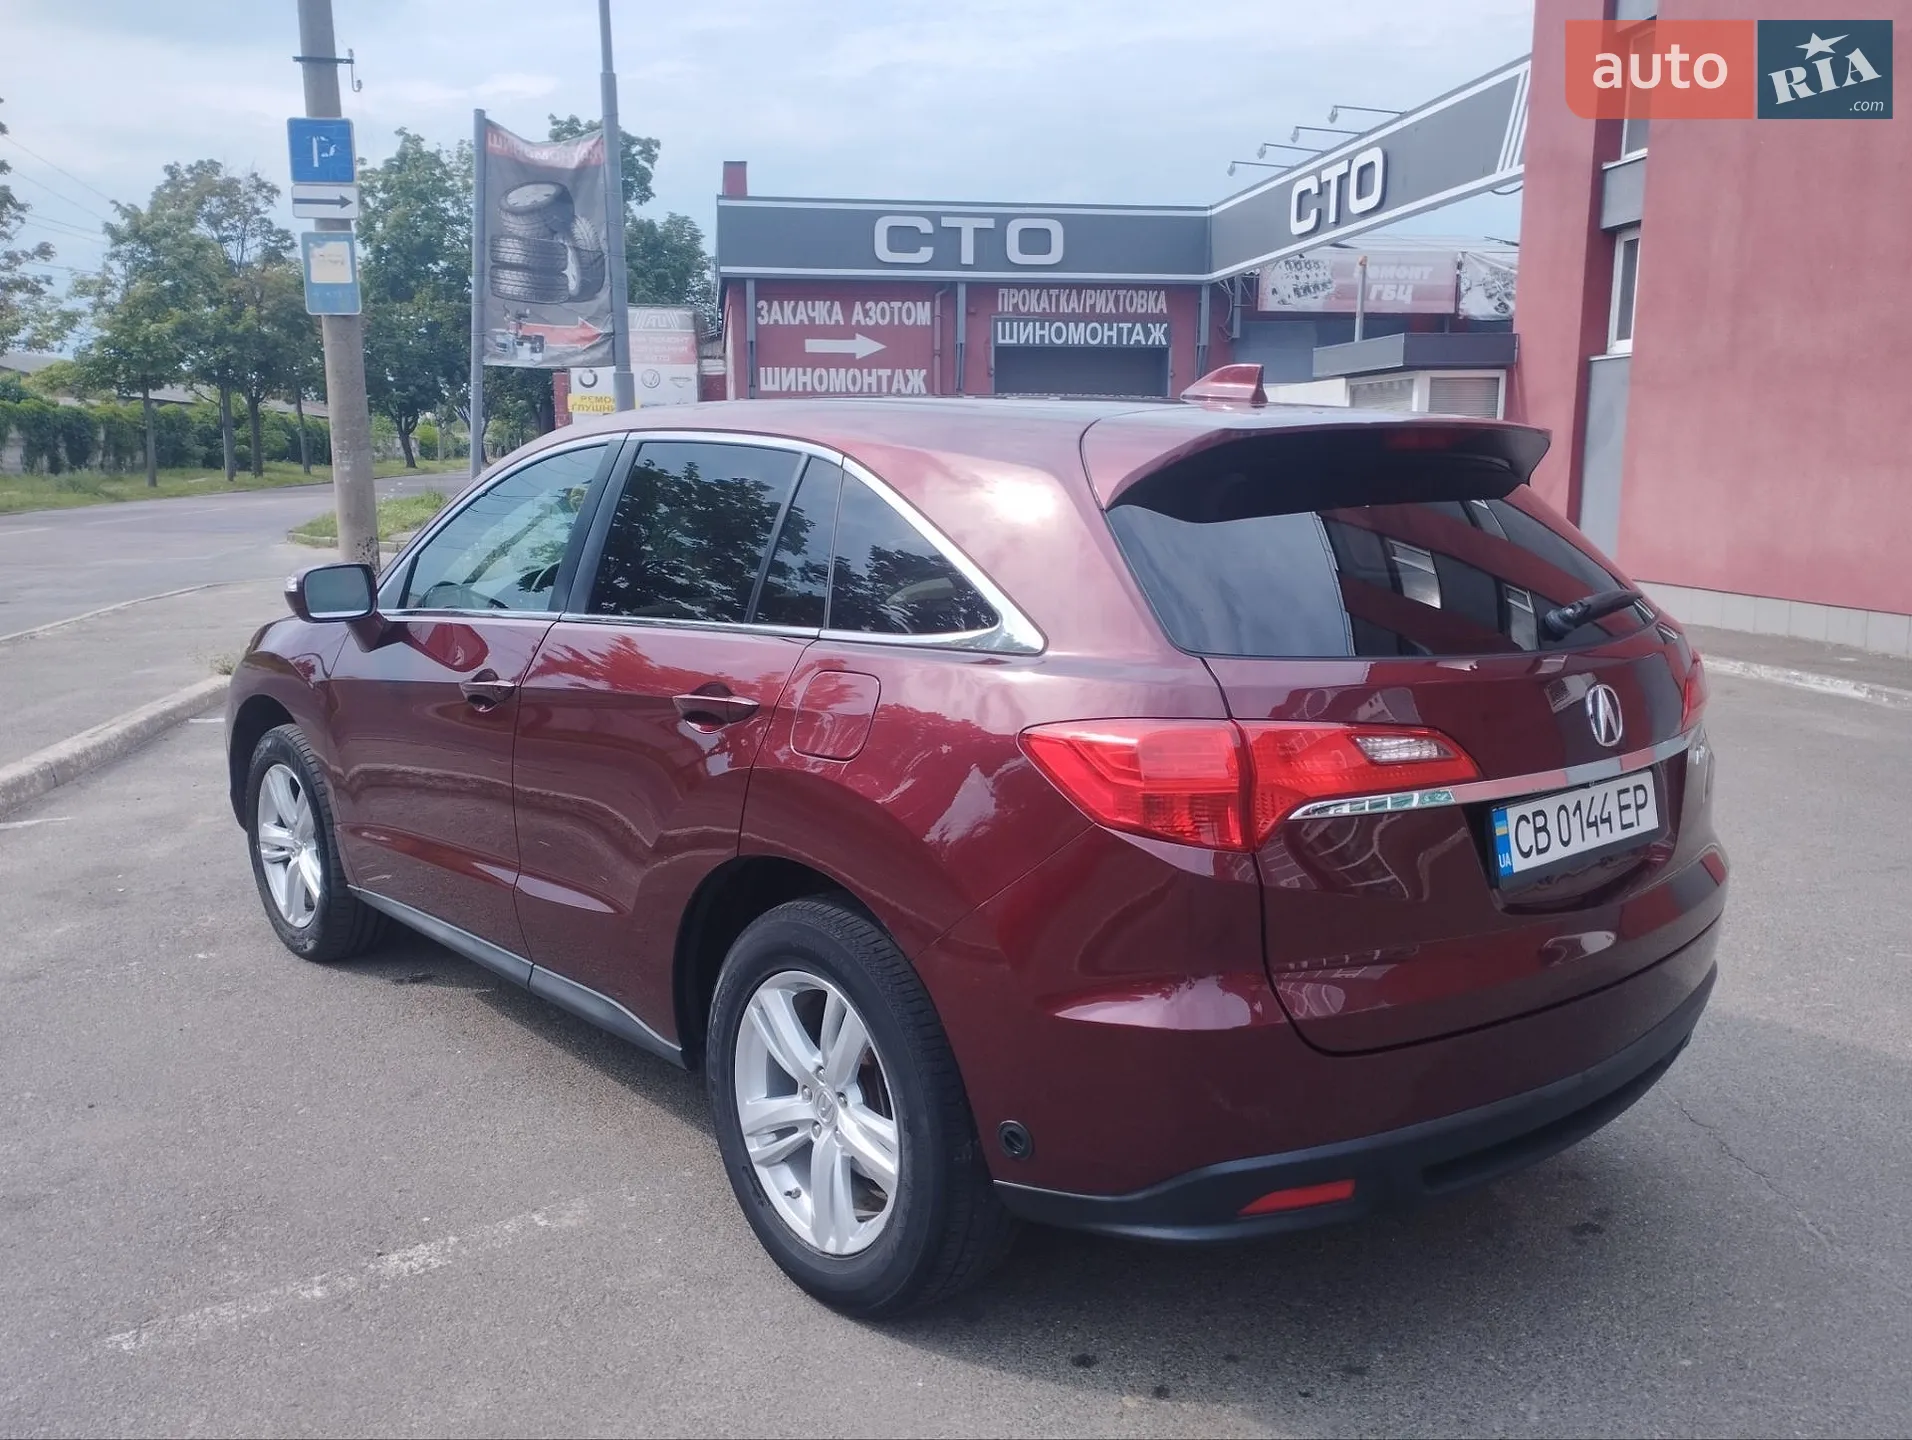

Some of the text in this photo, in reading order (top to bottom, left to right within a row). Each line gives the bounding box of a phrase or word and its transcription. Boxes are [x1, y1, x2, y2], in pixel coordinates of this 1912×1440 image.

[1290, 147, 1386, 236] СТО
[873, 215, 1064, 265] СТО
[756, 300, 931, 326] ЗАКАЧКА АЗОТОМ
[997, 288, 1168, 314] ПРОКАТКА/РИХТОВКА
[997, 321, 1168, 346] ШИНОМОНТАЖ
[759, 367, 927, 394] ШИНОМОНТАЖ
[580, 395, 615, 404] РЕМО
[1514, 784, 1648, 859] CB 0144 EP
[1498, 854, 1512, 869] UA
